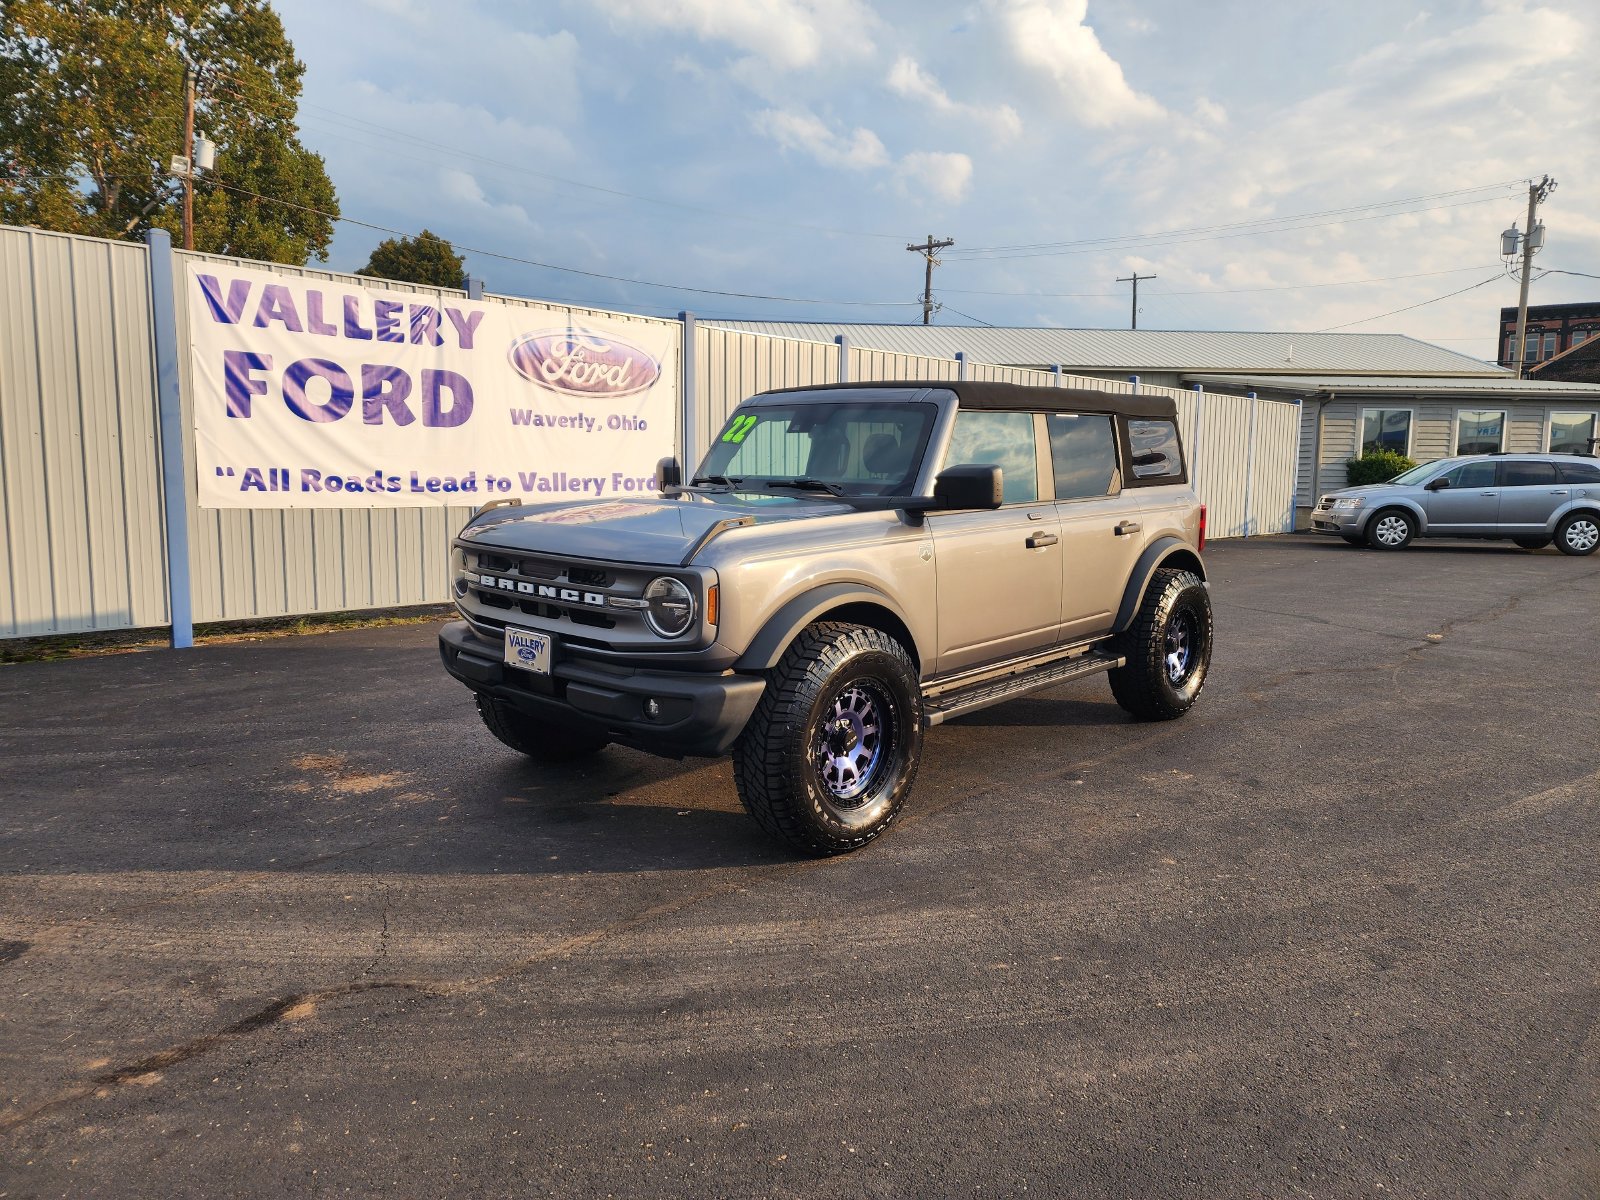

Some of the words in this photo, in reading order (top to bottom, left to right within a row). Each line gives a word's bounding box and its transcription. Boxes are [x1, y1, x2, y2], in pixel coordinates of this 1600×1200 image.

[197, 274, 485, 349] VALLERY
[541, 336, 633, 387] Ford
[224, 349, 474, 428] FORD
[509, 408, 602, 432] Waverly,
[606, 414, 648, 431] Ohio
[722, 414, 757, 443] 22
[301, 468, 401, 493] Roads
[410, 470, 478, 493] Lead
[485, 473, 512, 492] to
[518, 471, 606, 496] Vallery
[612, 472, 657, 492] Ford
[480, 575, 604, 605] BRONCO
[509, 634, 545, 655] VALLERY
